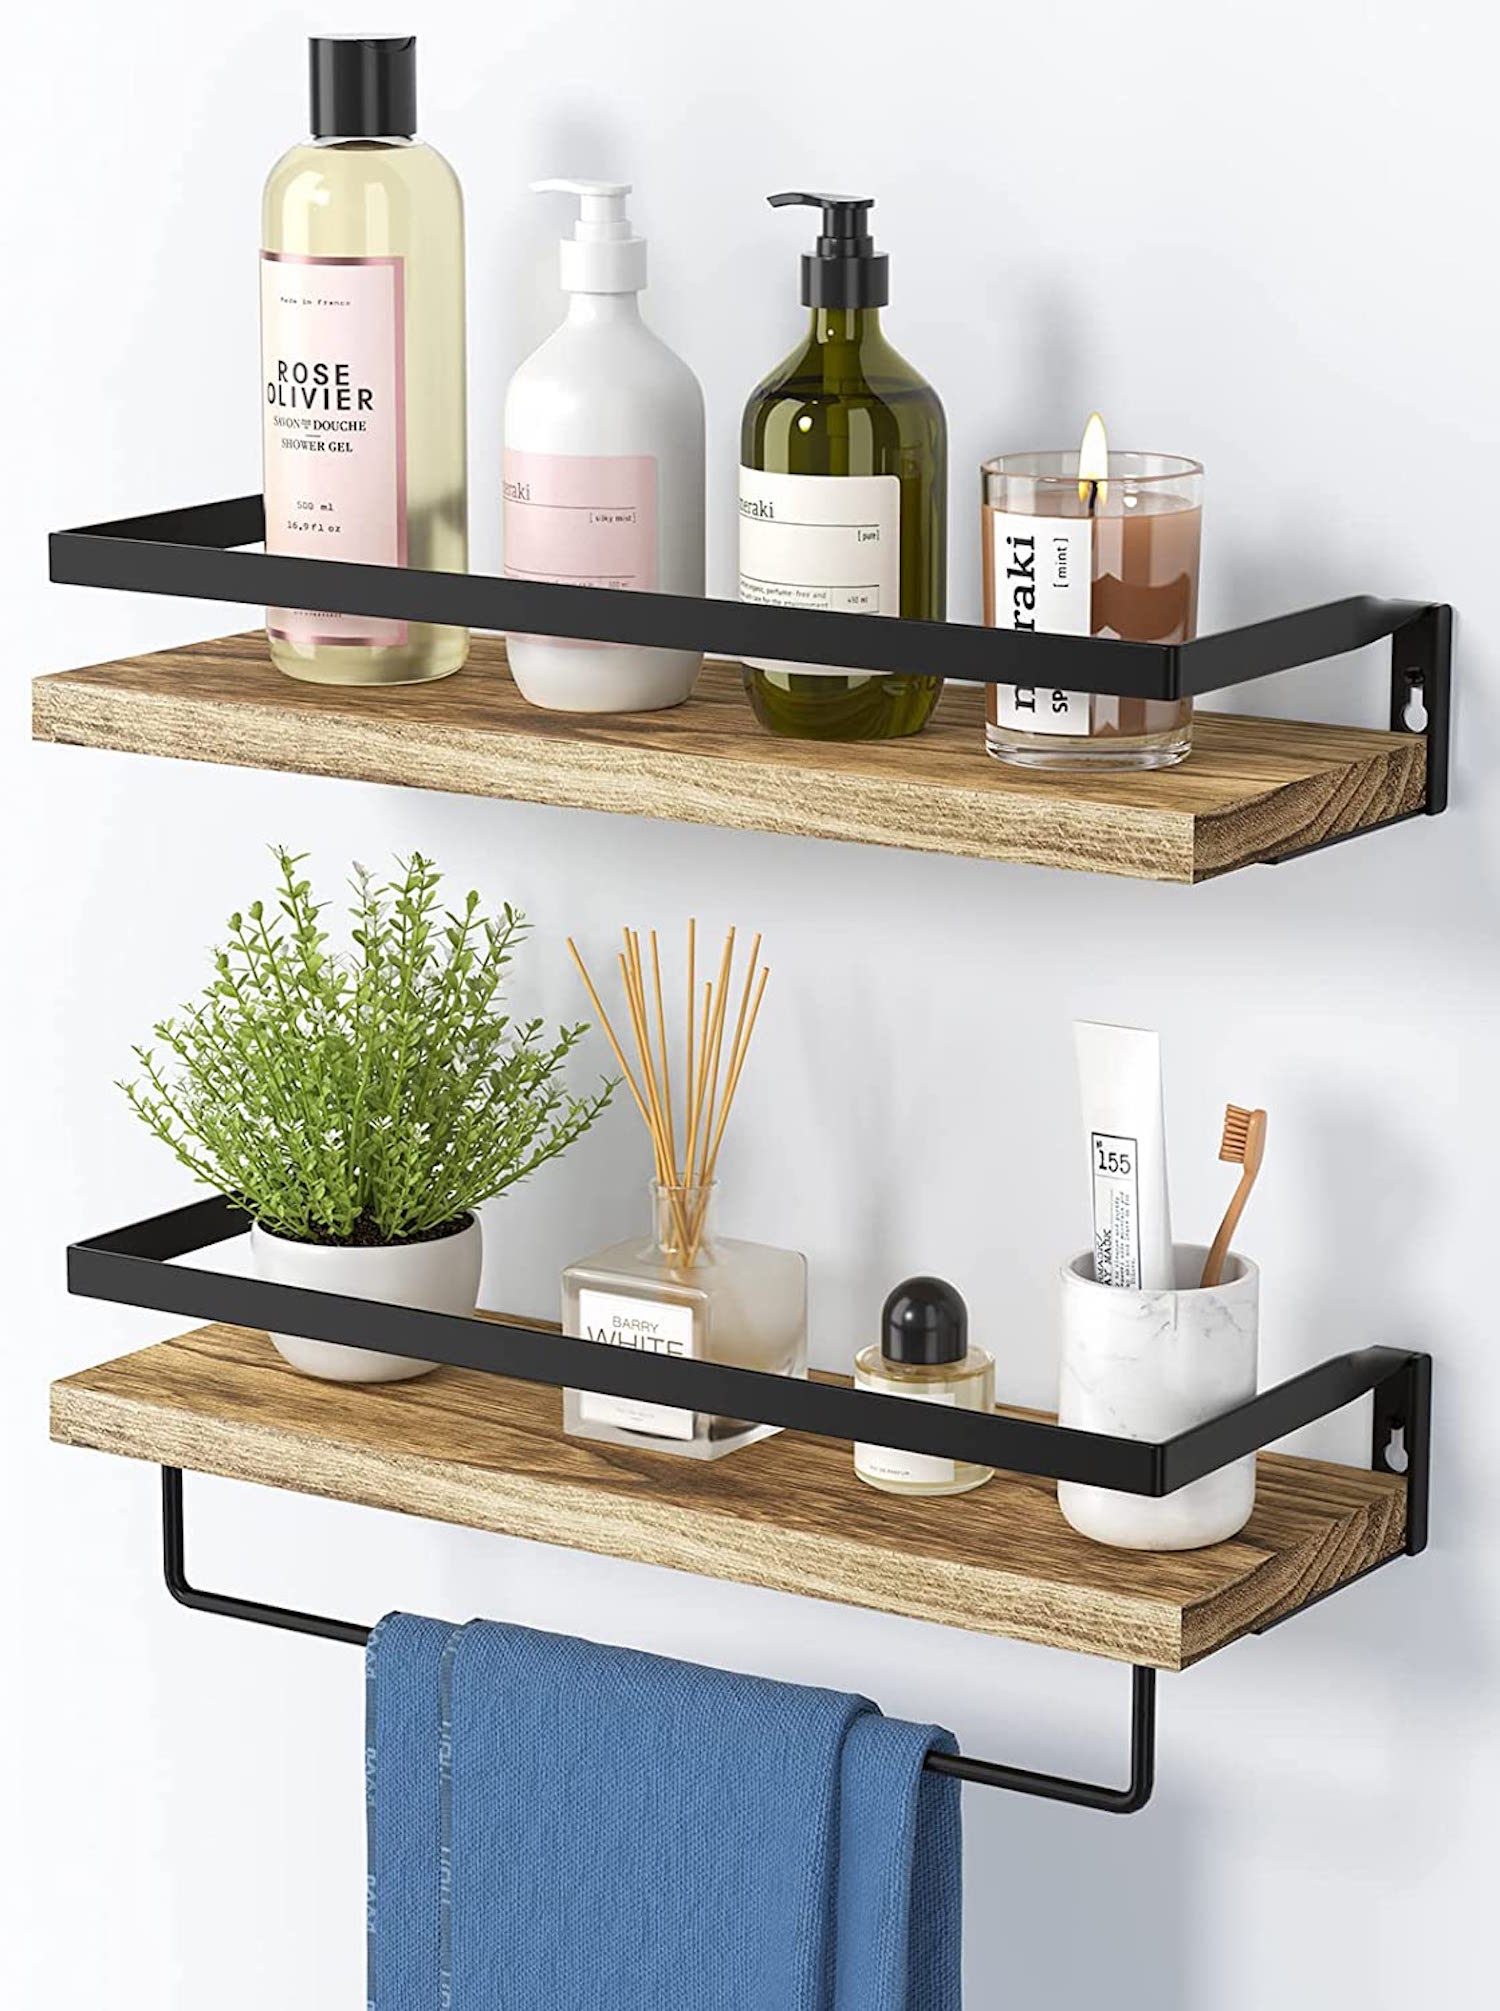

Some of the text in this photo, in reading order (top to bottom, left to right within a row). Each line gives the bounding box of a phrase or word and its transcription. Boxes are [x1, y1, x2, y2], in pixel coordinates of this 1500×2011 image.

[277, 359, 350, 386] ROSE
[267, 382, 374, 411] OLIVIER
[313, 419, 367, 432] DOUCHE
[281, 437, 354, 453] SHOWER GEL
[296, 500, 334, 512] 500 ml
[1099, 1149, 1132, 1175] 155
[612, 1315, 659, 1334] BARRY
